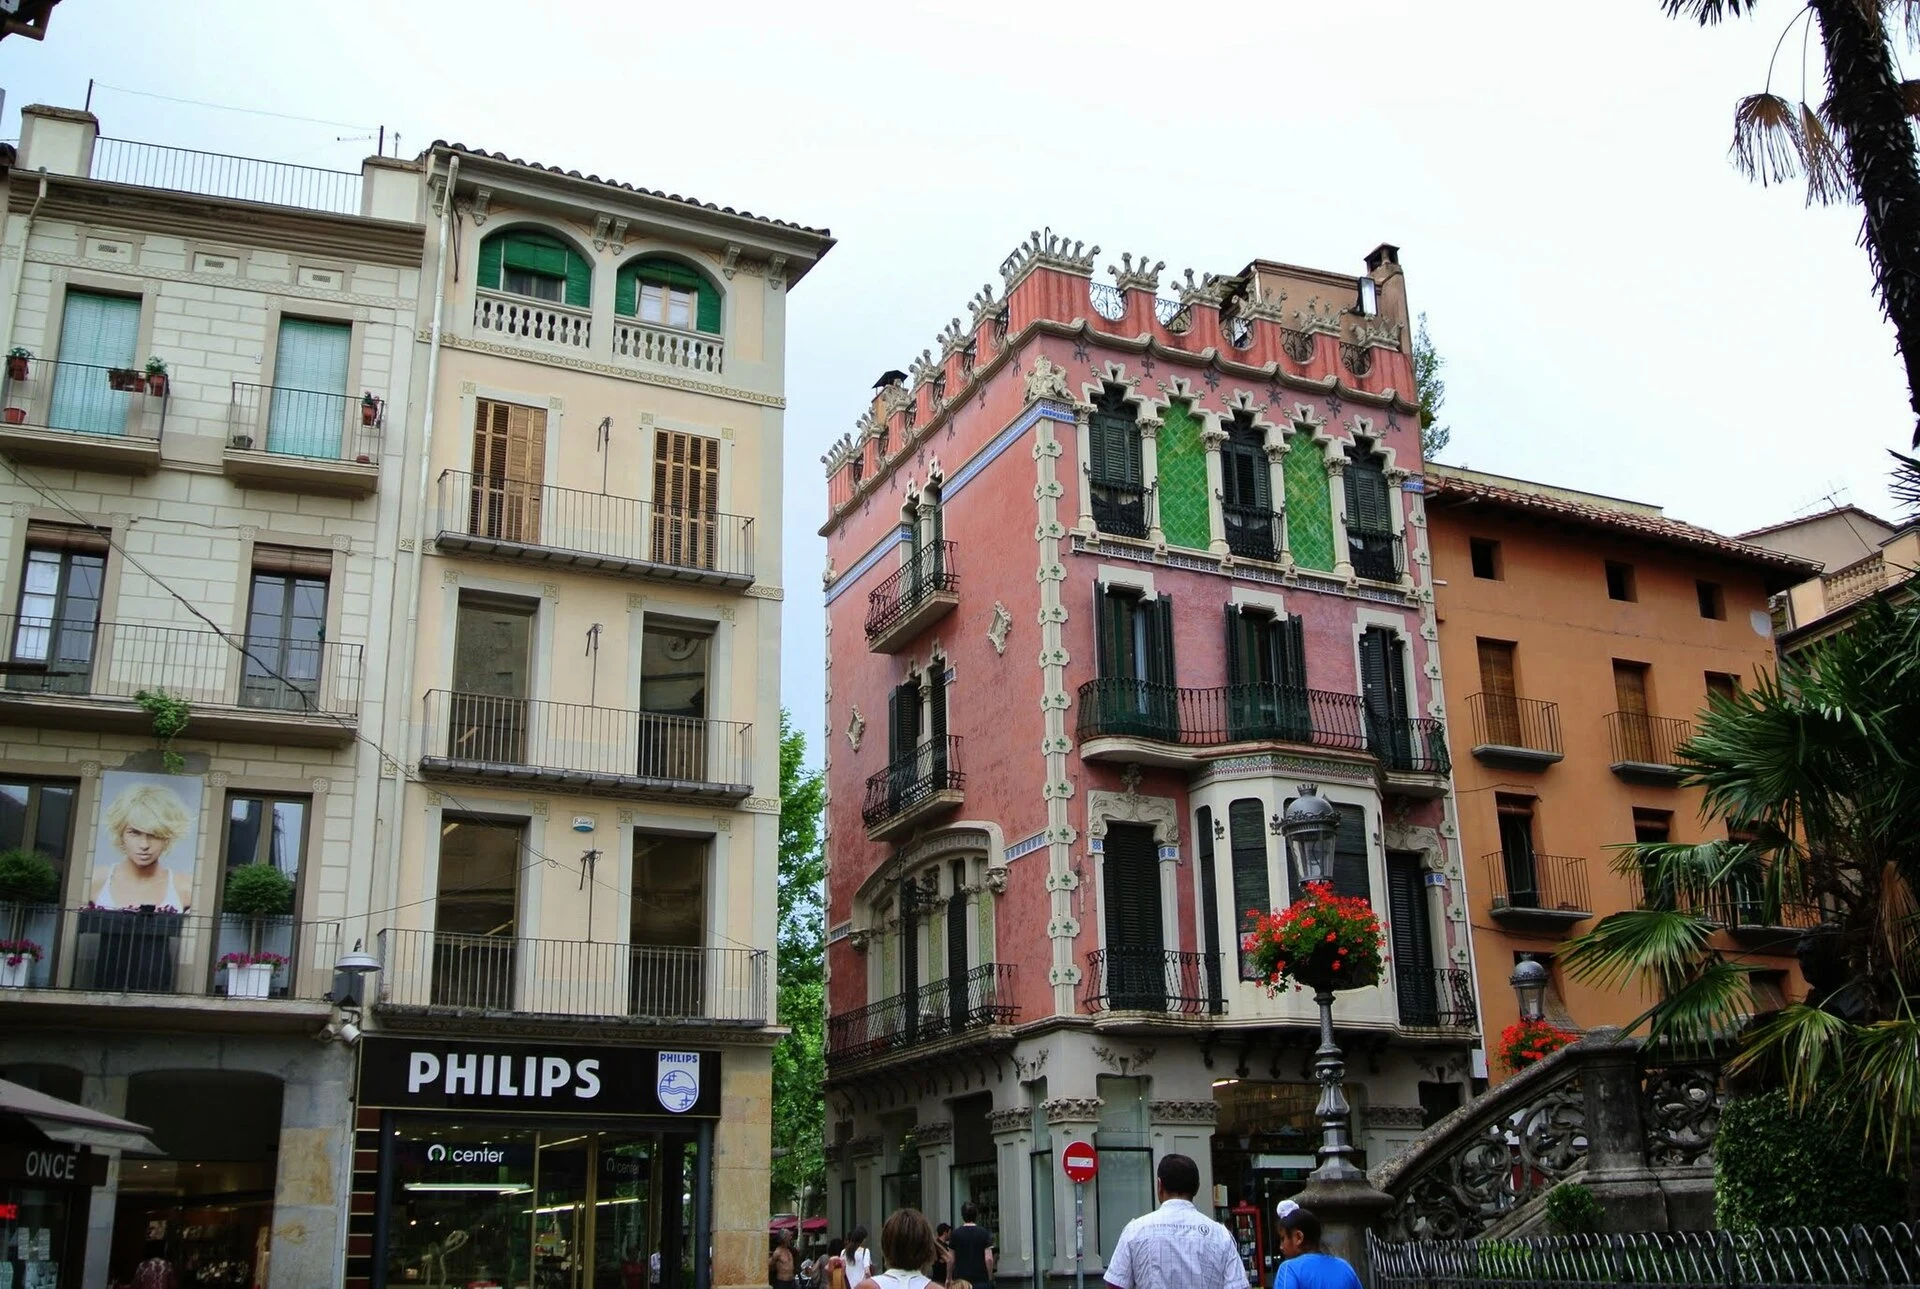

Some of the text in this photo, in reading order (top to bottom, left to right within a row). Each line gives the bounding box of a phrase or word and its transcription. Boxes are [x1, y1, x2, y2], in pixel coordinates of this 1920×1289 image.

[660, 1053, 698, 1063] PHILIPS
[408, 1052, 600, 1098] PHILIPS
[26, 1151, 76, 1179] ONCE
